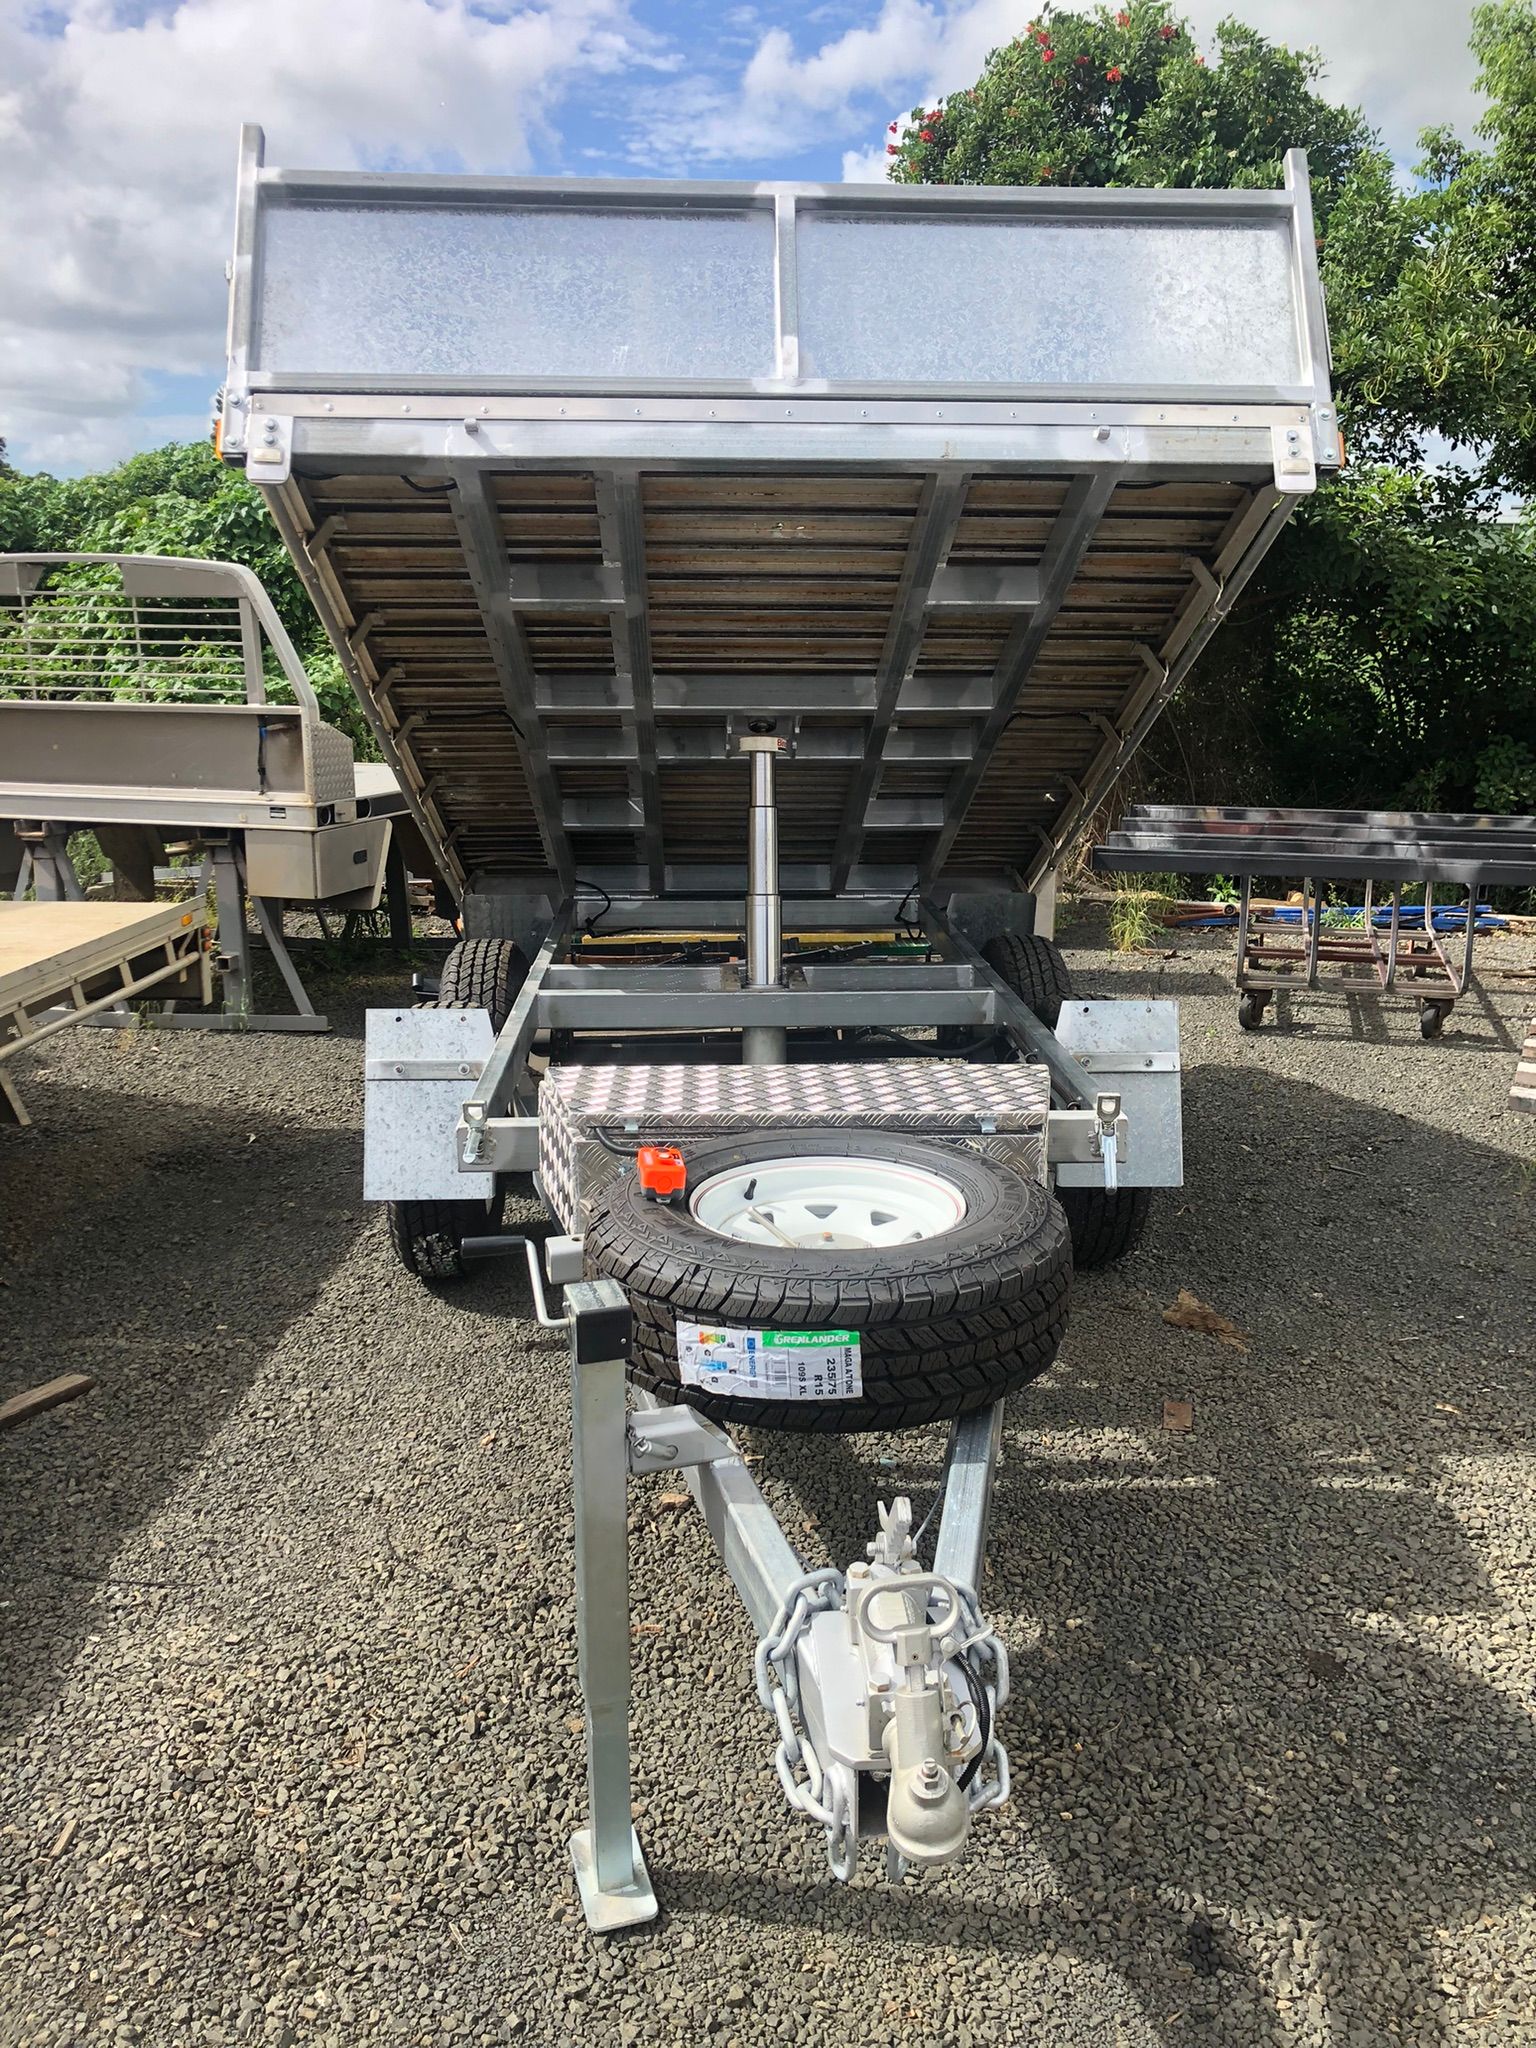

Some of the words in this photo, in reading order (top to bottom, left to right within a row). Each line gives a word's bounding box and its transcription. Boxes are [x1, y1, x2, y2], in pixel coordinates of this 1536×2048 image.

[774, 1334, 850, 1344] GRENLANDER
[844, 1347, 852, 1367] MAGA
[798, 1361, 807, 1382] 109S
[826, 1358, 837, 1395] 235/75
[799, 1385, 807, 1396] XL
[814, 1374, 824, 1396] R15
